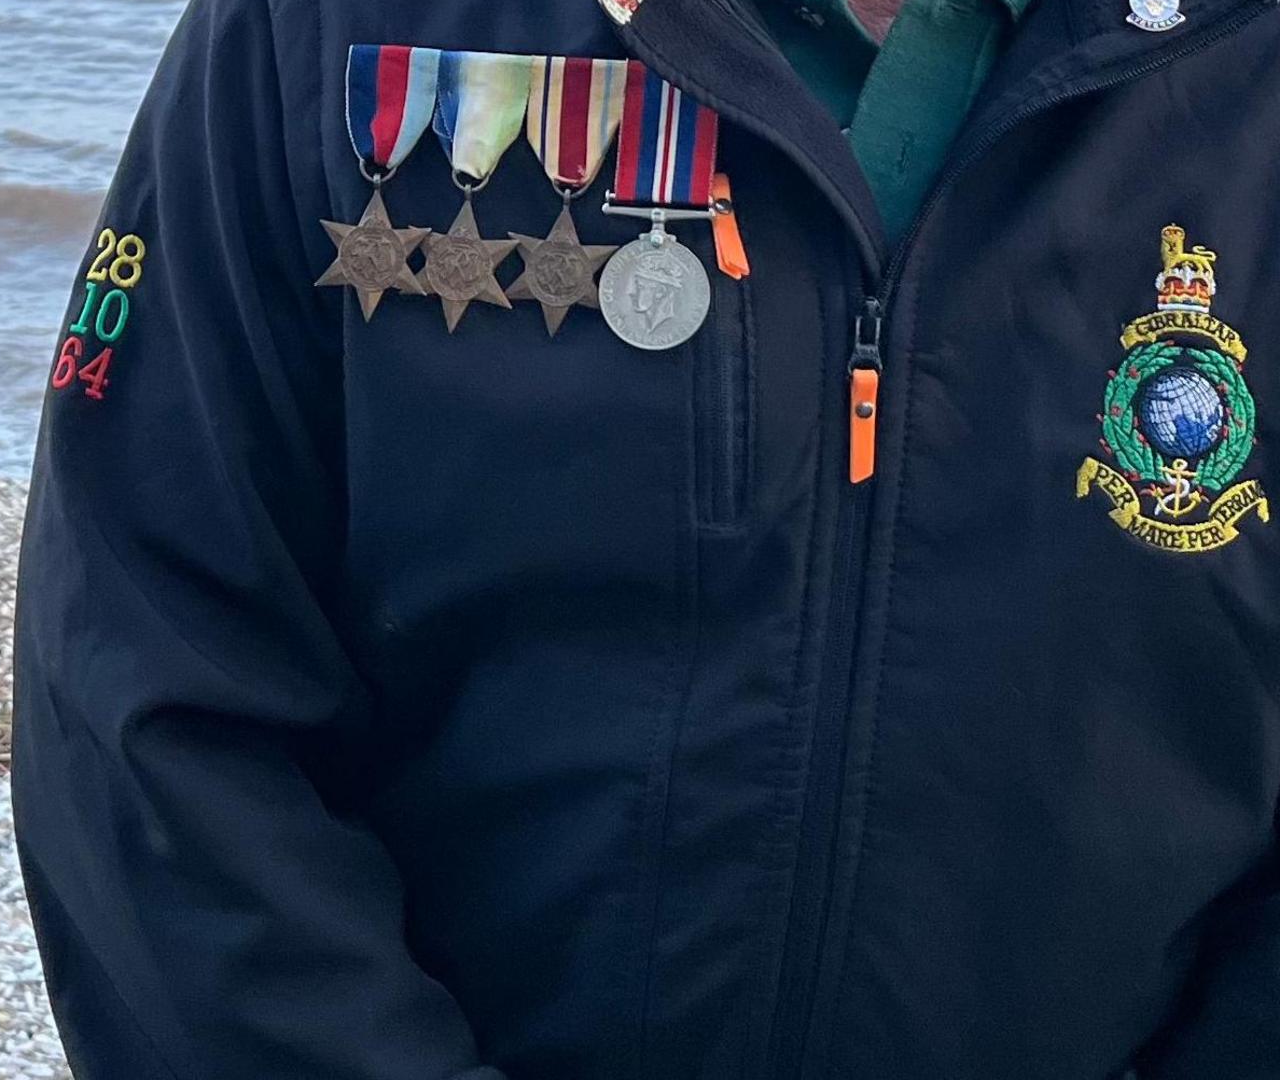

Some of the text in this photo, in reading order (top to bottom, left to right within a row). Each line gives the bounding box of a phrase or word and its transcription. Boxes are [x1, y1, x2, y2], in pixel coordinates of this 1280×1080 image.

[86, 228, 146, 288] 28
[70, 281, 129, 342] 10
[1135, 312, 1236, 347] GIBRALTAR
[52, 336, 113, 400] 64
[1096, 466, 1136, 511] PER
[1127, 513, 1184, 549] MARE
[1187, 524, 1224, 549] PER
